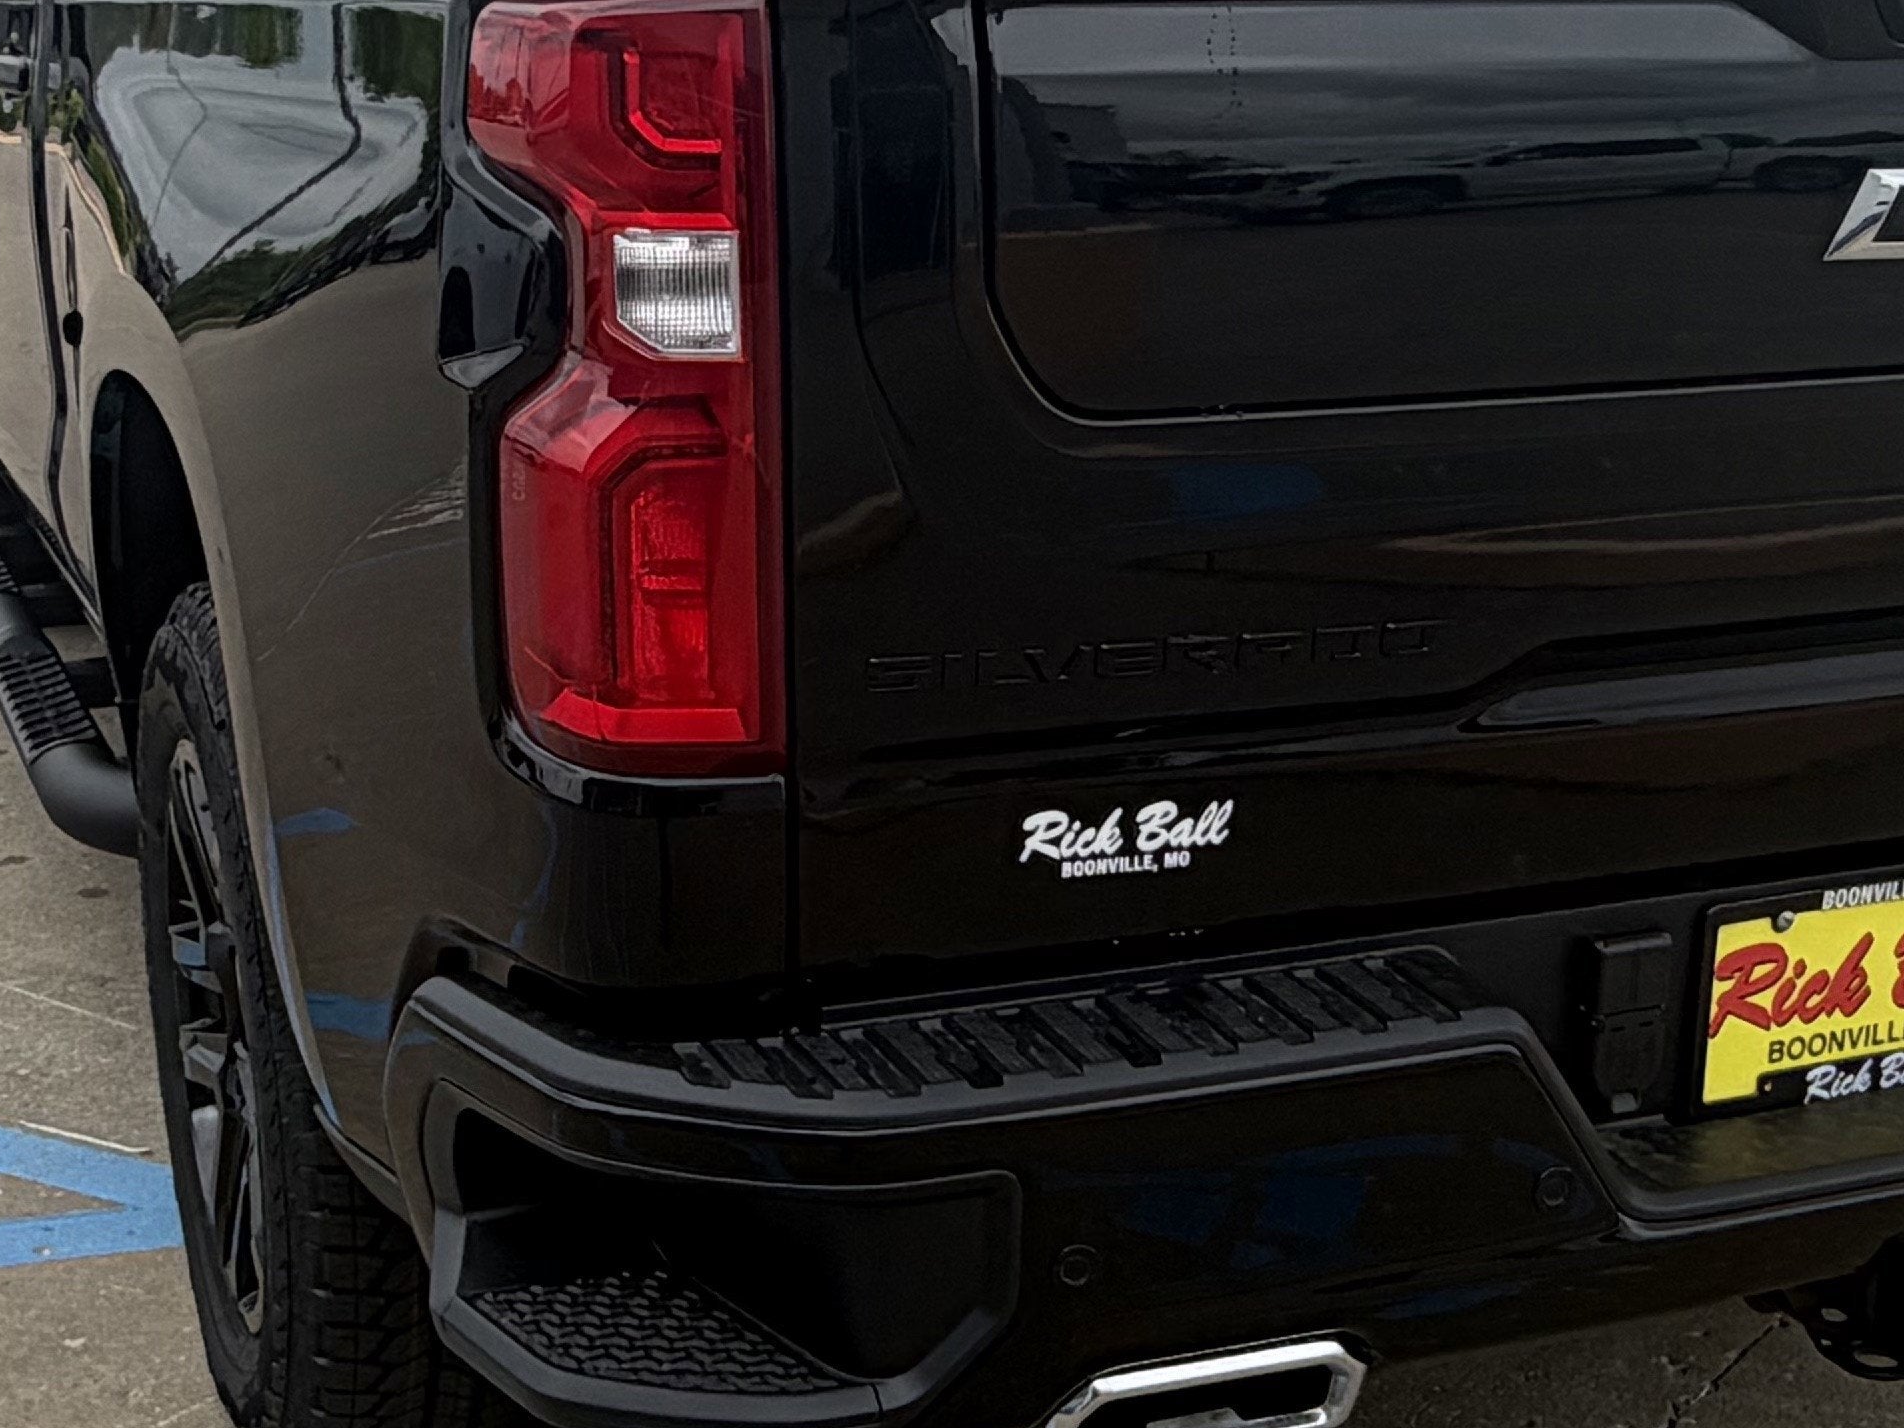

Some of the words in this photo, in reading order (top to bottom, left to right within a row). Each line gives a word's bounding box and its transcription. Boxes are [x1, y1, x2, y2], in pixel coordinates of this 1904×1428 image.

[865, 618, 1453, 693] SILVERADO
[1018, 806, 1124, 863] Rick
[1134, 798, 1235, 852] Ball
[1061, 854, 1158, 878] BOONVILLE,
[1163, 849, 1191, 869] MO
[1707, 931, 1876, 1039] Rick
[1802, 1061, 1873, 1105] Rick
